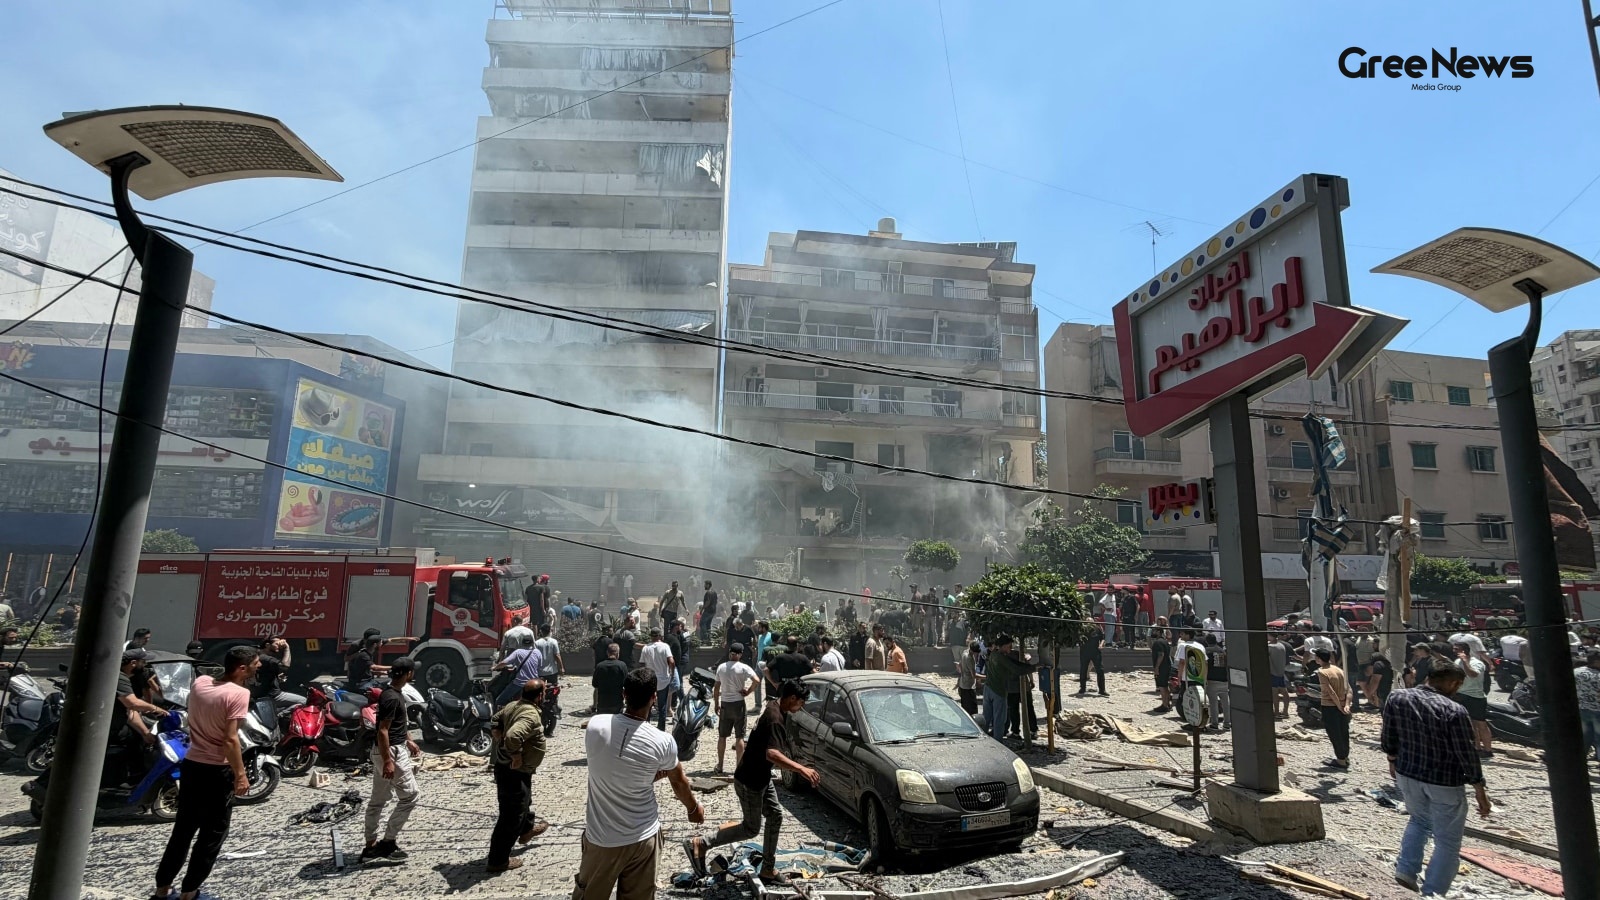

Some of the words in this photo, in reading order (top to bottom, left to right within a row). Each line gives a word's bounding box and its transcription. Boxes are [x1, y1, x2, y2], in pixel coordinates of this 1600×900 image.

[1188, 251, 1250, 311] افران
[1149, 257, 1305, 394] ابراهيم
[221, 565, 255, 580] الجنوبية
[255, 565, 286, 580] الضاحية
[286, 566, 312, 580] بلديات
[218, 585, 269, 603] الضاحية
[271, 585, 302, 604] إطفاء
[303, 586, 328, 604] فوج
[284, 608, 326, 623] مركز
